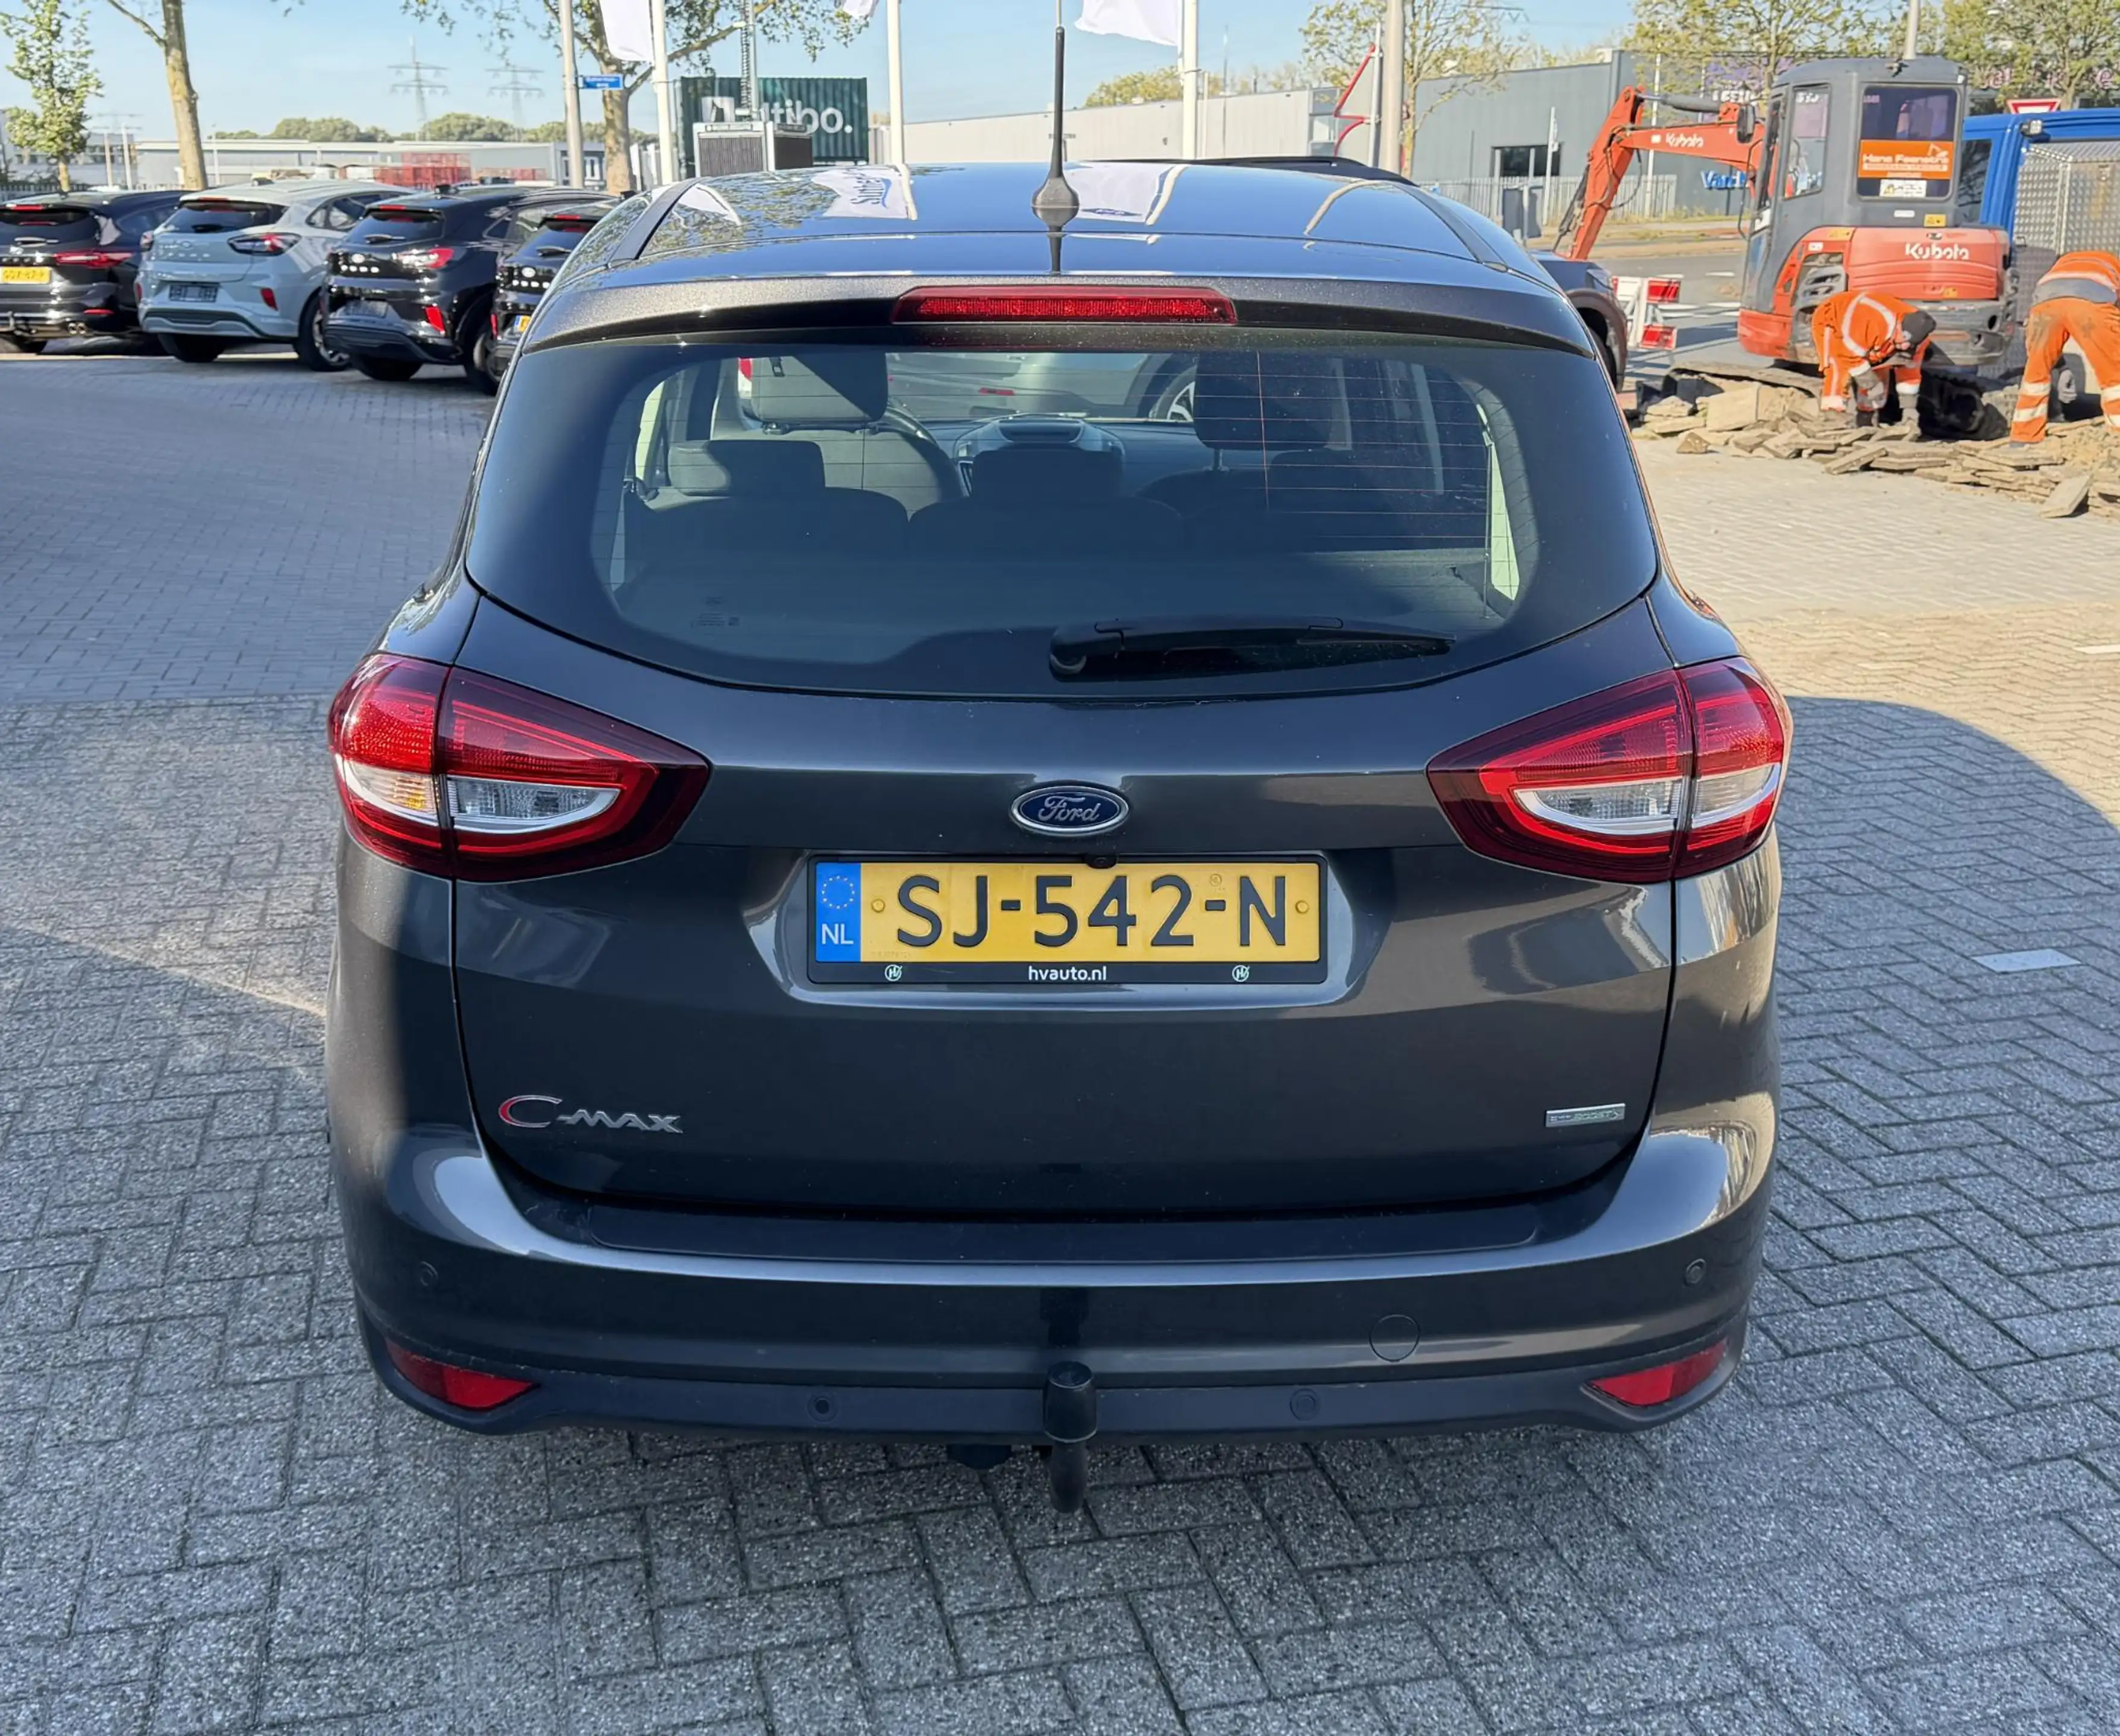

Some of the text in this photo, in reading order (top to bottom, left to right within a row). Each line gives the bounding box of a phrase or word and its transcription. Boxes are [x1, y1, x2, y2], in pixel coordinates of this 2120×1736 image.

[1905, 243, 1969, 260] Kubota
[1038, 796, 1101, 822] Ford
[896, 875, 1286, 948] SJ-542-N
[822, 923, 854, 945] NL
[1028, 966, 1107, 981] hvauto.nl
